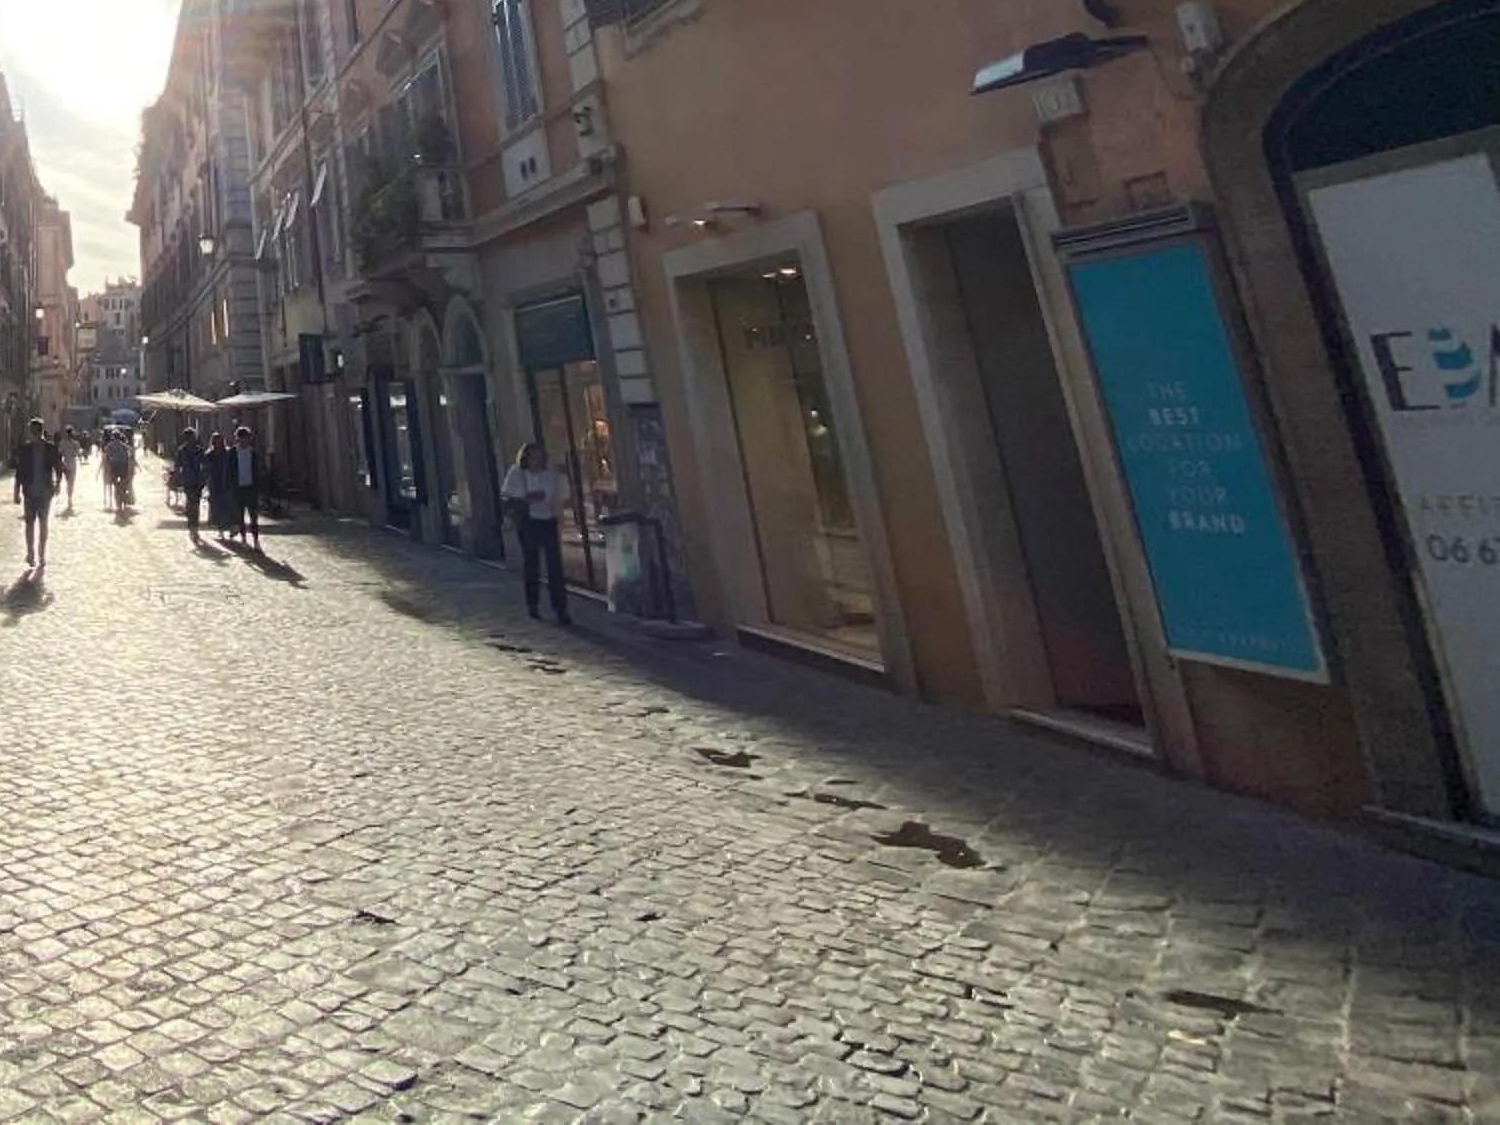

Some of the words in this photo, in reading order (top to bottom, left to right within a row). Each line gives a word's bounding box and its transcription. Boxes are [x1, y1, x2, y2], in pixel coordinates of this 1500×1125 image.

[1148, 406, 1201, 426] BEST
[1169, 510, 1246, 535] BRAND
[1426, 534, 1468, 564] 06
